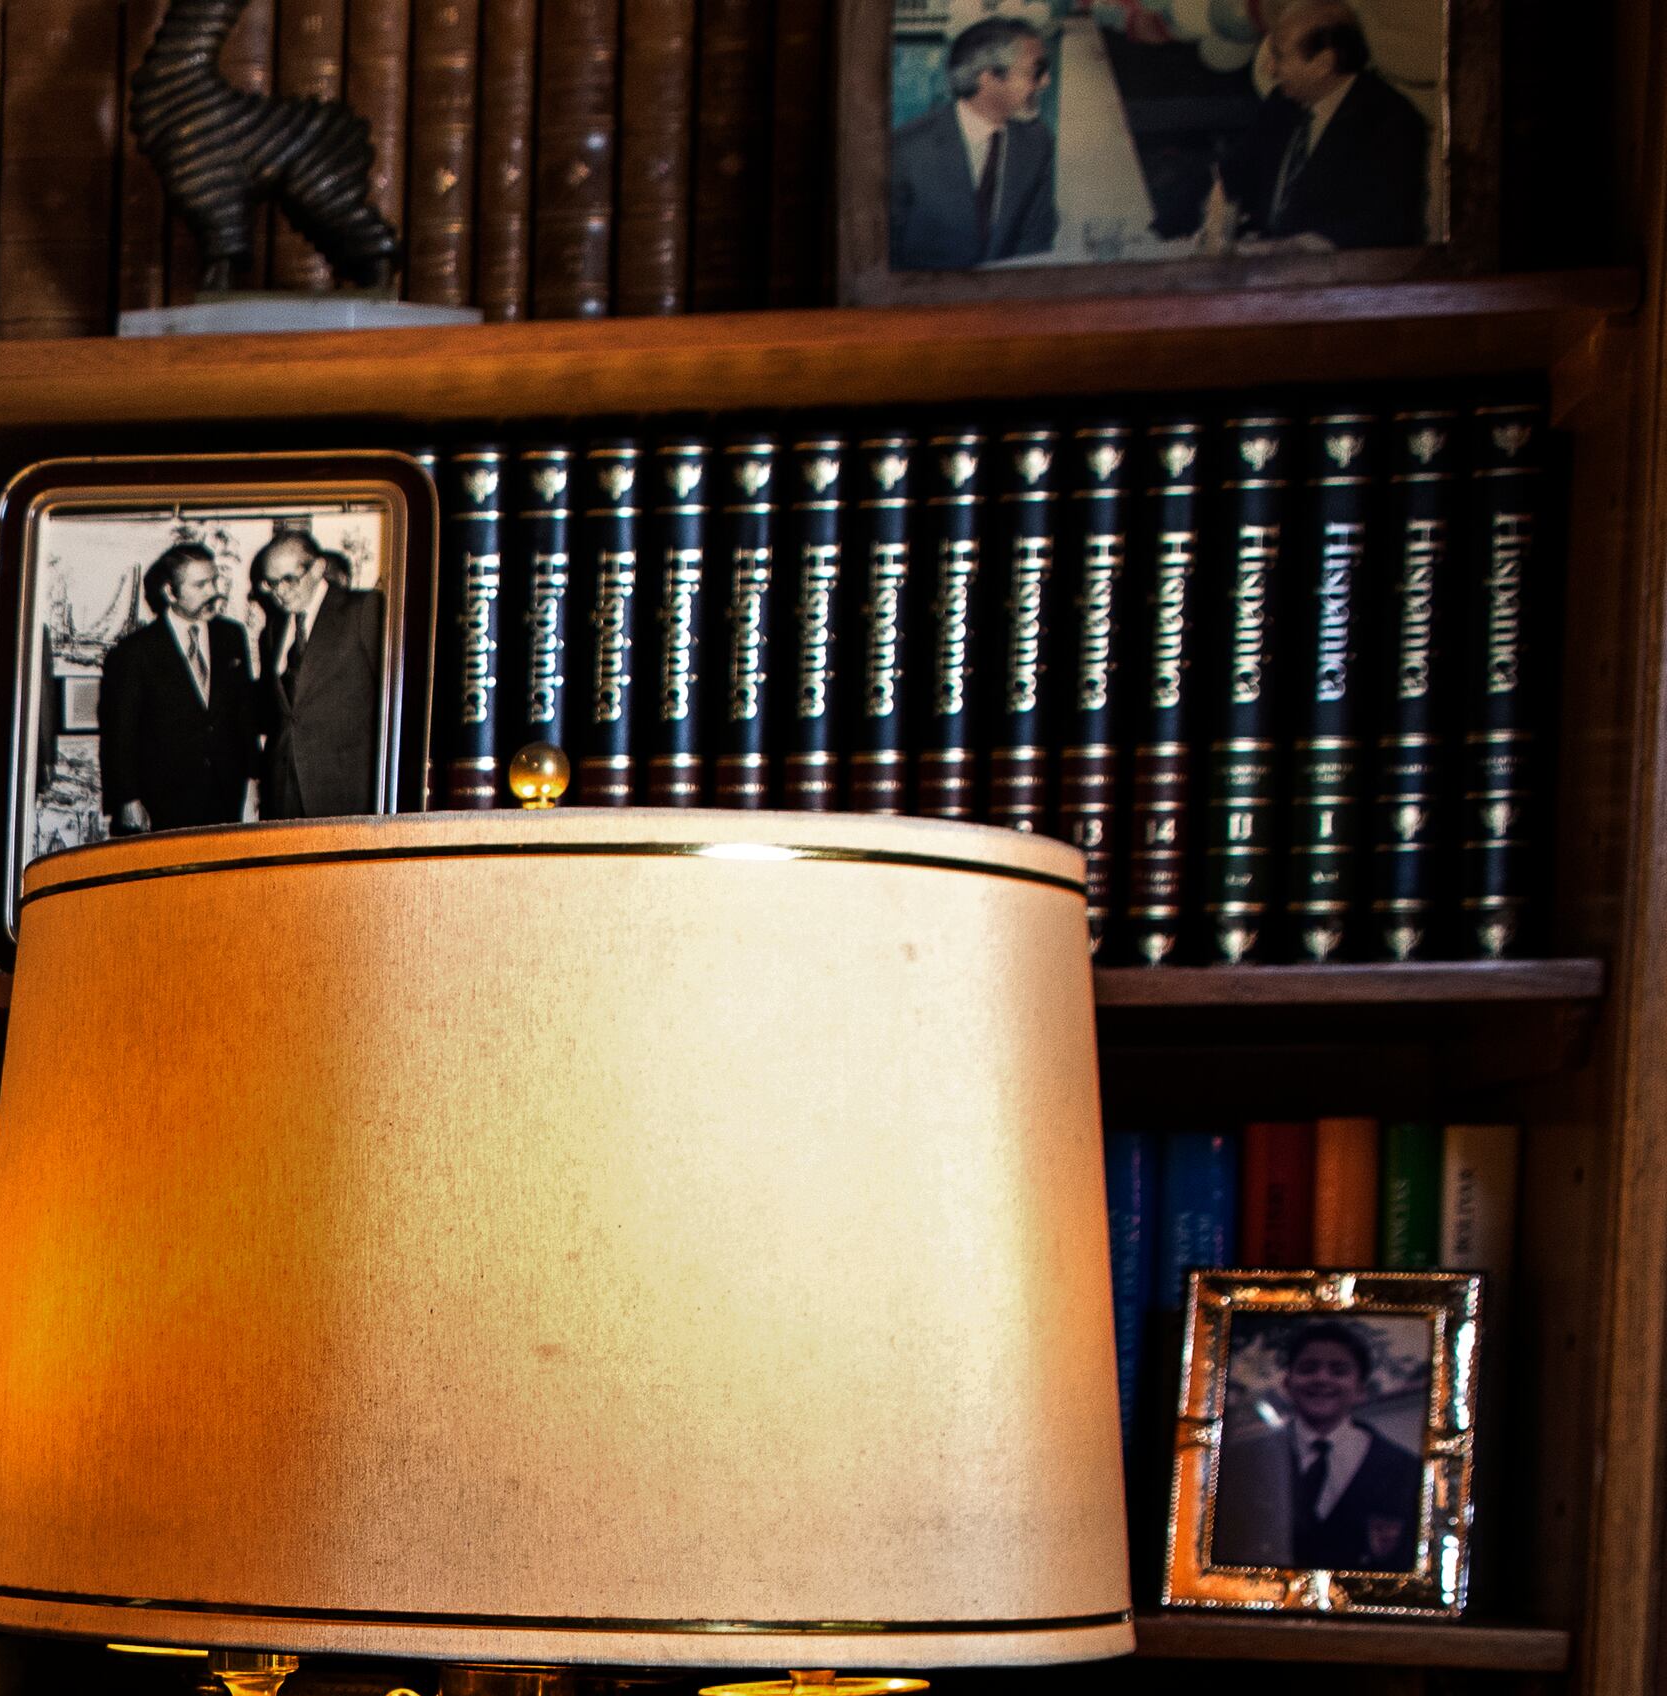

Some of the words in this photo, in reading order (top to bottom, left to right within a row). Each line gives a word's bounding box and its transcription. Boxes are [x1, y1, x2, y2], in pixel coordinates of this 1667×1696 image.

[458, 552, 500, 724] Hispánica
[524, 552, 569, 724] Hispánica
[590, 551, 636, 724] Hispánica
[656, 548, 704, 722] Hispánica
[725, 546, 773, 722] Hispánica
[792, 542, 843, 719] Hispánica
[860, 540, 911, 718] Hispánica
[929, 537, 980, 716] Hispánica
[1003, 535, 1055, 714] Hispánica
[1074, 534, 1126, 712] Hispánica
[1147, 530, 1200, 710] Hispánica
[1227, 523, 1282, 705] Hispánica
[1312, 521, 1367, 702] Hispánica
[1394, 518, 1447, 701] Hispánica
[1481, 512, 1534, 695] Hispánica
[1072, 818, 1104, 845] 13
[1144, 817, 1176, 845] 14
